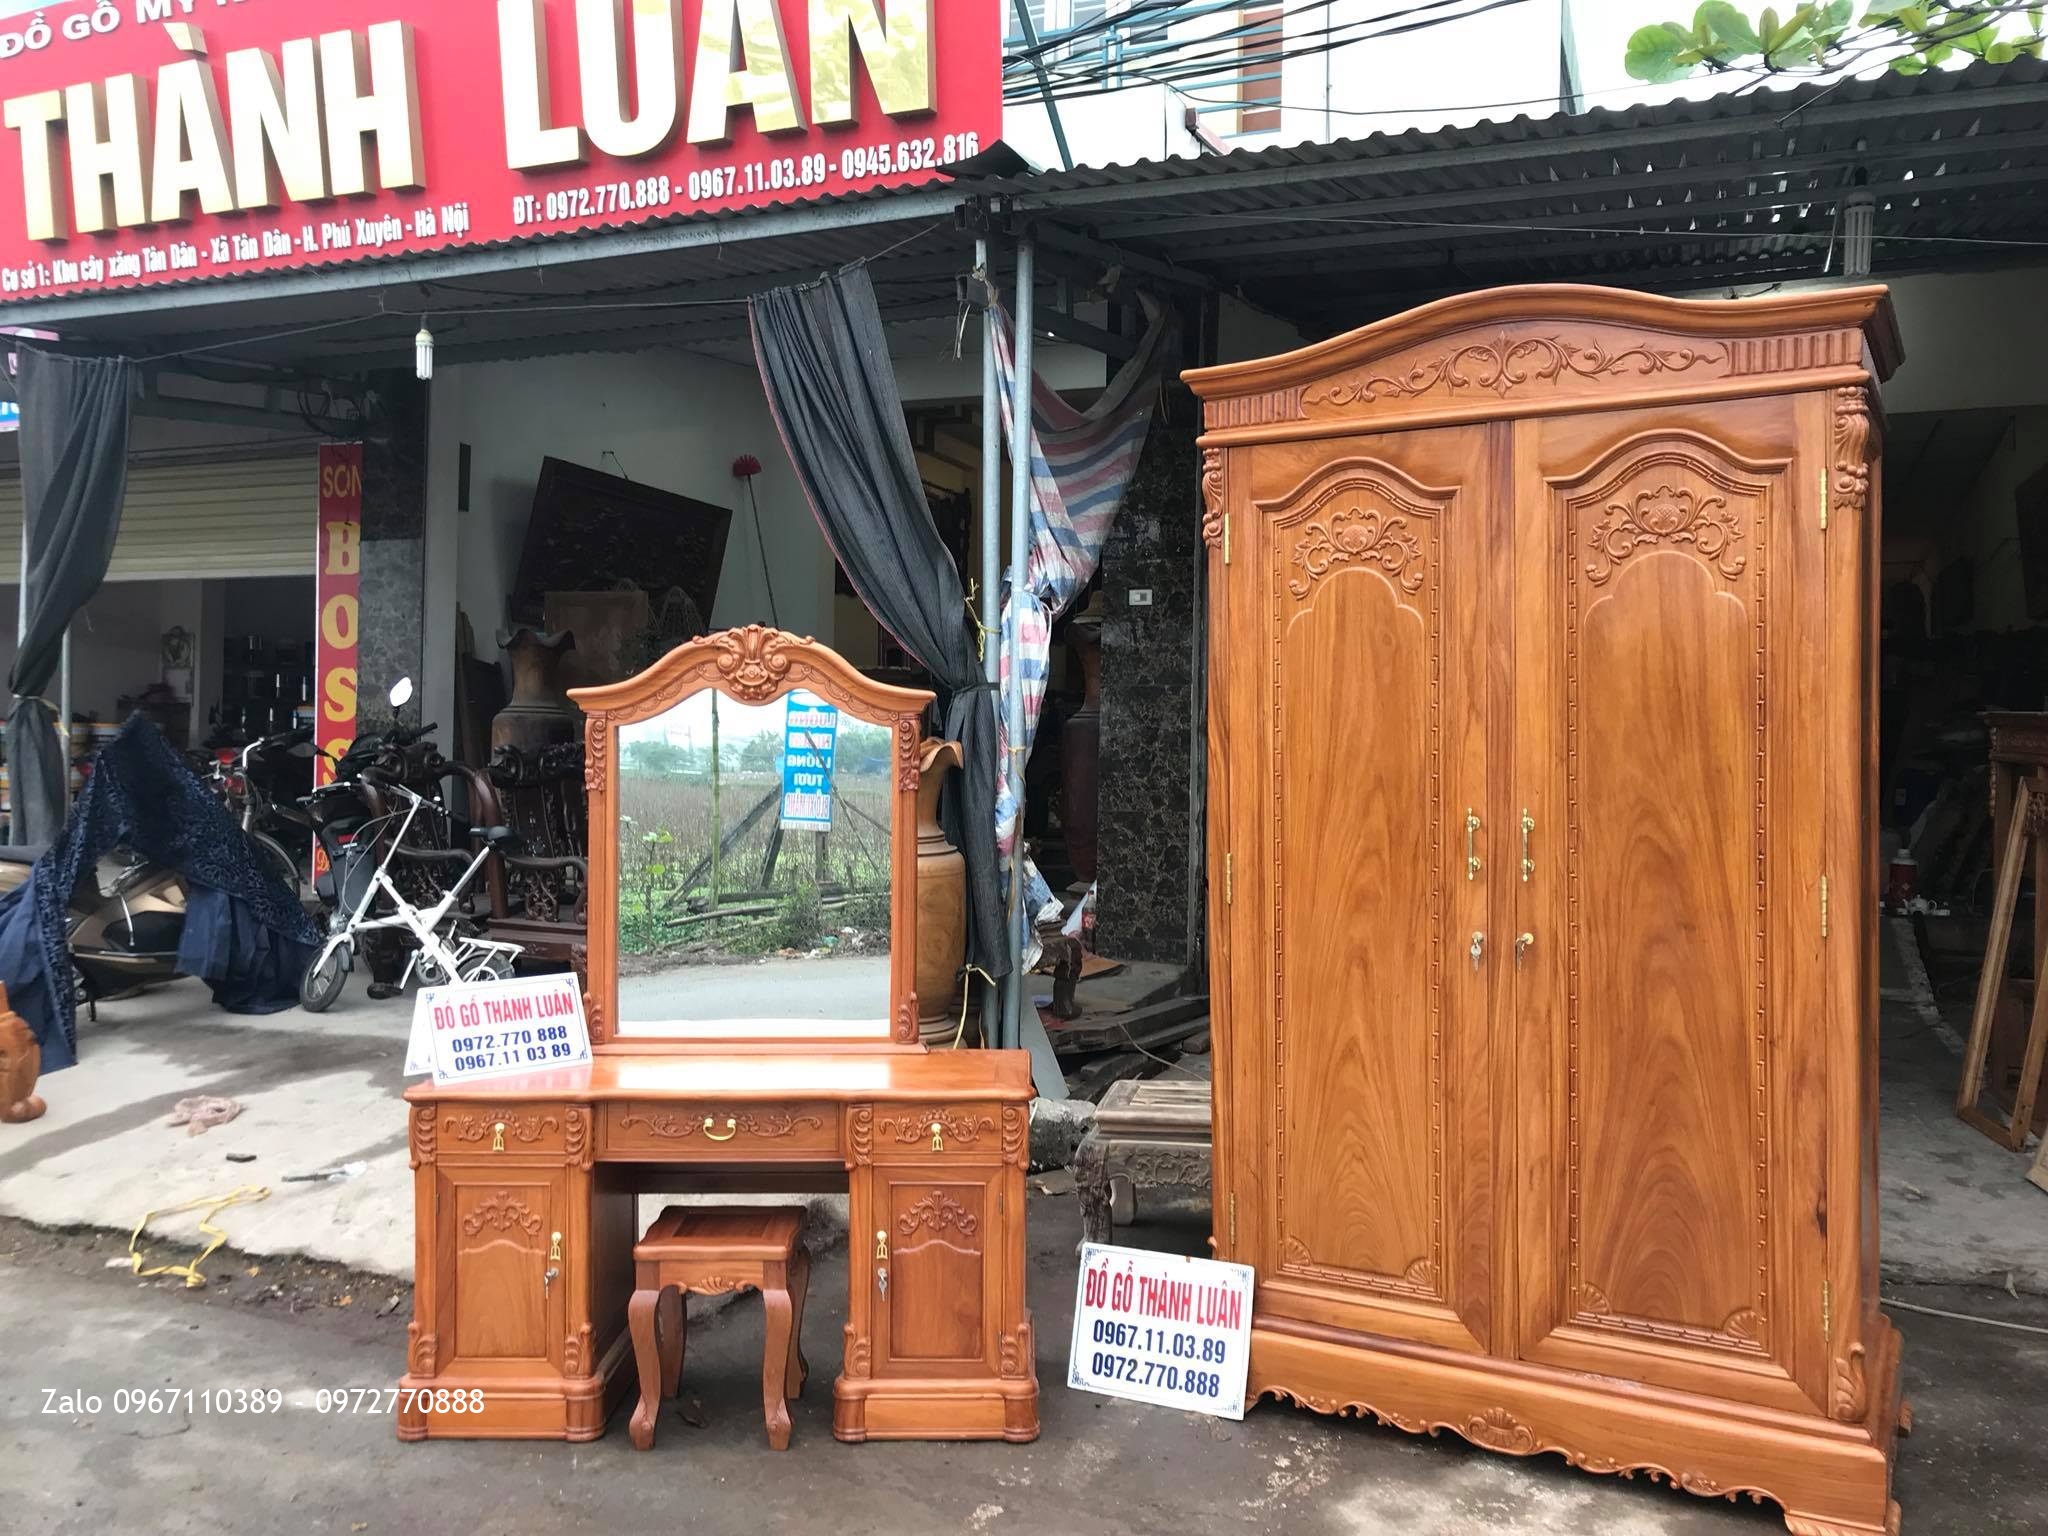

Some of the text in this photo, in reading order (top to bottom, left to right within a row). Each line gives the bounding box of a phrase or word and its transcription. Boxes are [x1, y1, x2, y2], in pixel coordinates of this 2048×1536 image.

[0, 11, 52, 58] ĐỒ
[4, 20, 422, 243] THÀNH
[513, 194, 542, 225] ĐT:
[546, 175, 670, 221] 0972.770.888
[688, 152, 826, 201] 0967.11.03.89
[842, 131, 978, 181] 0945.632.816
[37, 263, 50, 287] 1:
[52, 259, 79, 285] Khu
[81, 254, 104, 283] cây
[108, 251, 141, 279] xăng
[142, 246, 168, 273] Tân
[170, 241, 198, 269] Dân
[210, 235, 230, 264] Xã
[232, 232, 259, 261] Tân
[262, 229, 292, 257] Dân
[302, 225, 319, 252] H.
[322, 219, 351, 250] Phú
[355, 214, 402, 248] Xuyên
[415, 207, 437, 238] Hà
[441, 202, 470, 239] Nội
[535, 989, 574, 1018] LUÂN
[1085, 1258, 1242, 1331] ĐỒ GỖ THÀNH LUÂN
[1093, 1319, 1226, 1364] 0967.11.03.89
[1092, 1352, 1220, 1397] 0972.770.888
